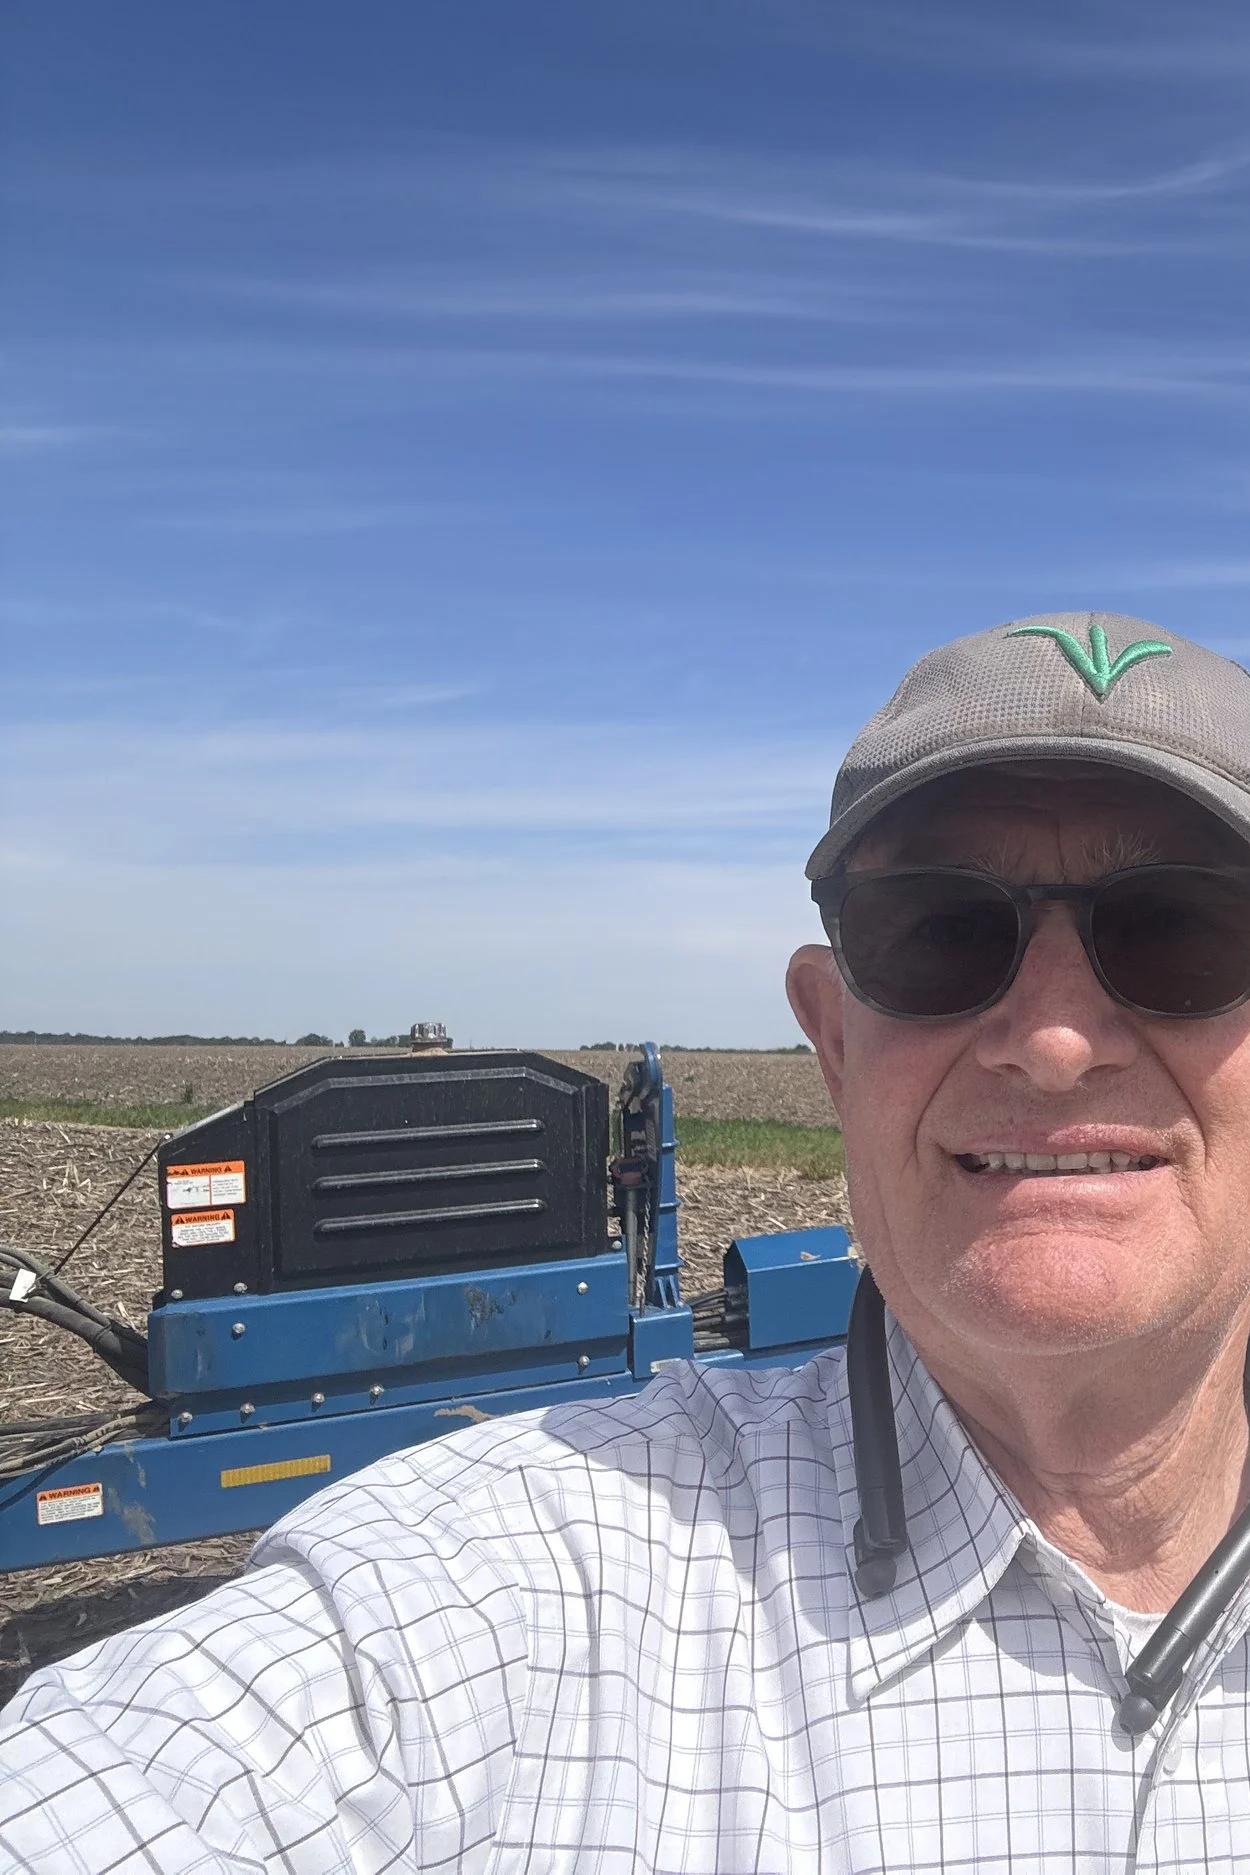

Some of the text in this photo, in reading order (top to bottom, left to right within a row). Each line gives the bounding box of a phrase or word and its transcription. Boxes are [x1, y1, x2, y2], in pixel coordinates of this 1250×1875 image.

[190, 1166, 222, 1175] WARNING
[185, 1214, 220, 1224] WARNING
[48, 1486, 91, 1499] WARNING
